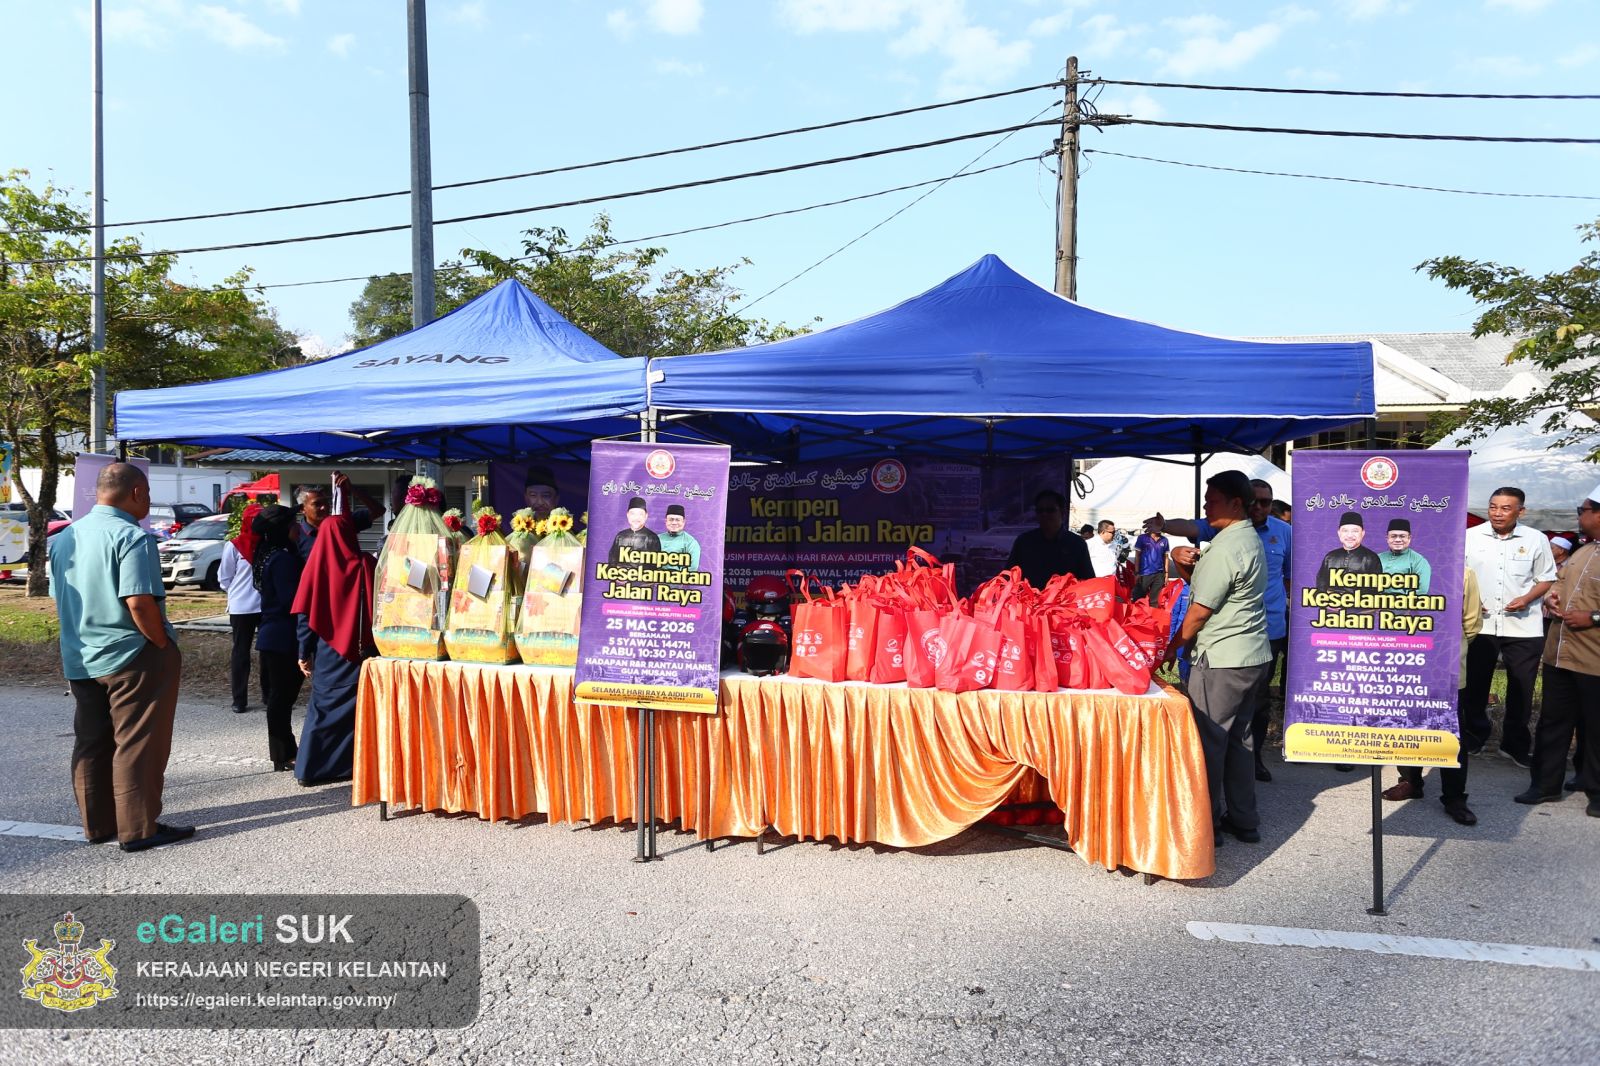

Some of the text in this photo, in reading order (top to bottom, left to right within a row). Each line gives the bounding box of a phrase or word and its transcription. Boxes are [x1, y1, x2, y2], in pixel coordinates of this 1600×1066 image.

[352, 353, 511, 369] SAYANG
[750, 497, 839, 521] Kempen
[808, 520, 871, 543] Jalan
[877, 520, 934, 545] Raya
[619, 547, 691, 568] Kempen
[820, 554, 844, 562] RAYA
[848, 554, 894, 562] AIDILFITRI
[596, 563, 711, 585] Keselamatan
[729, 568, 751, 576] 2026
[1329, 568, 1419, 592] Kempen
[603, 582, 701, 606] Jalan Raya
[1302, 588, 1445, 611] Keselamatan
[606, 618, 695, 633] 25 MAC 2026
[1311, 610, 1433, 635] Jalan Raya
[629, 631, 671, 639] BERSAMAAN
[609, 637, 690, 649] 5 SYAWAL 1447H
[602, 646, 696, 659] RABU, 10:30 PAGI
[1316, 650, 1426, 665] 25 MAC 2026
[585, 658, 628, 666] HADAPAN
[685, 664, 714, 672] MANIS,
[1346, 665, 1397, 673] BERSAMAAN
[641, 669, 678, 677] MUSANG
[1321, 671, 1421, 684] 5 SYAWAL 1447H
[592, 686, 625, 695] SELAMAT
[627, 688, 644, 696] HARI
[668, 691, 703, 699] AIDILFITRI
[1313, 681, 1428, 696] RABU, 10:30 PAGI
[1294, 695, 1452, 710] HADAPAN R&R RANTAU MANIS,
[1338, 706, 1407, 717] GUA MUSANG
[1304, 728, 1442, 743] SELAMAT HARI RAYA AIDILFITRI
[1326, 738, 1352, 746] MAAF
[1354, 740, 1380, 748] ZAHIR
[1392, 741, 1420, 749] BATIN
